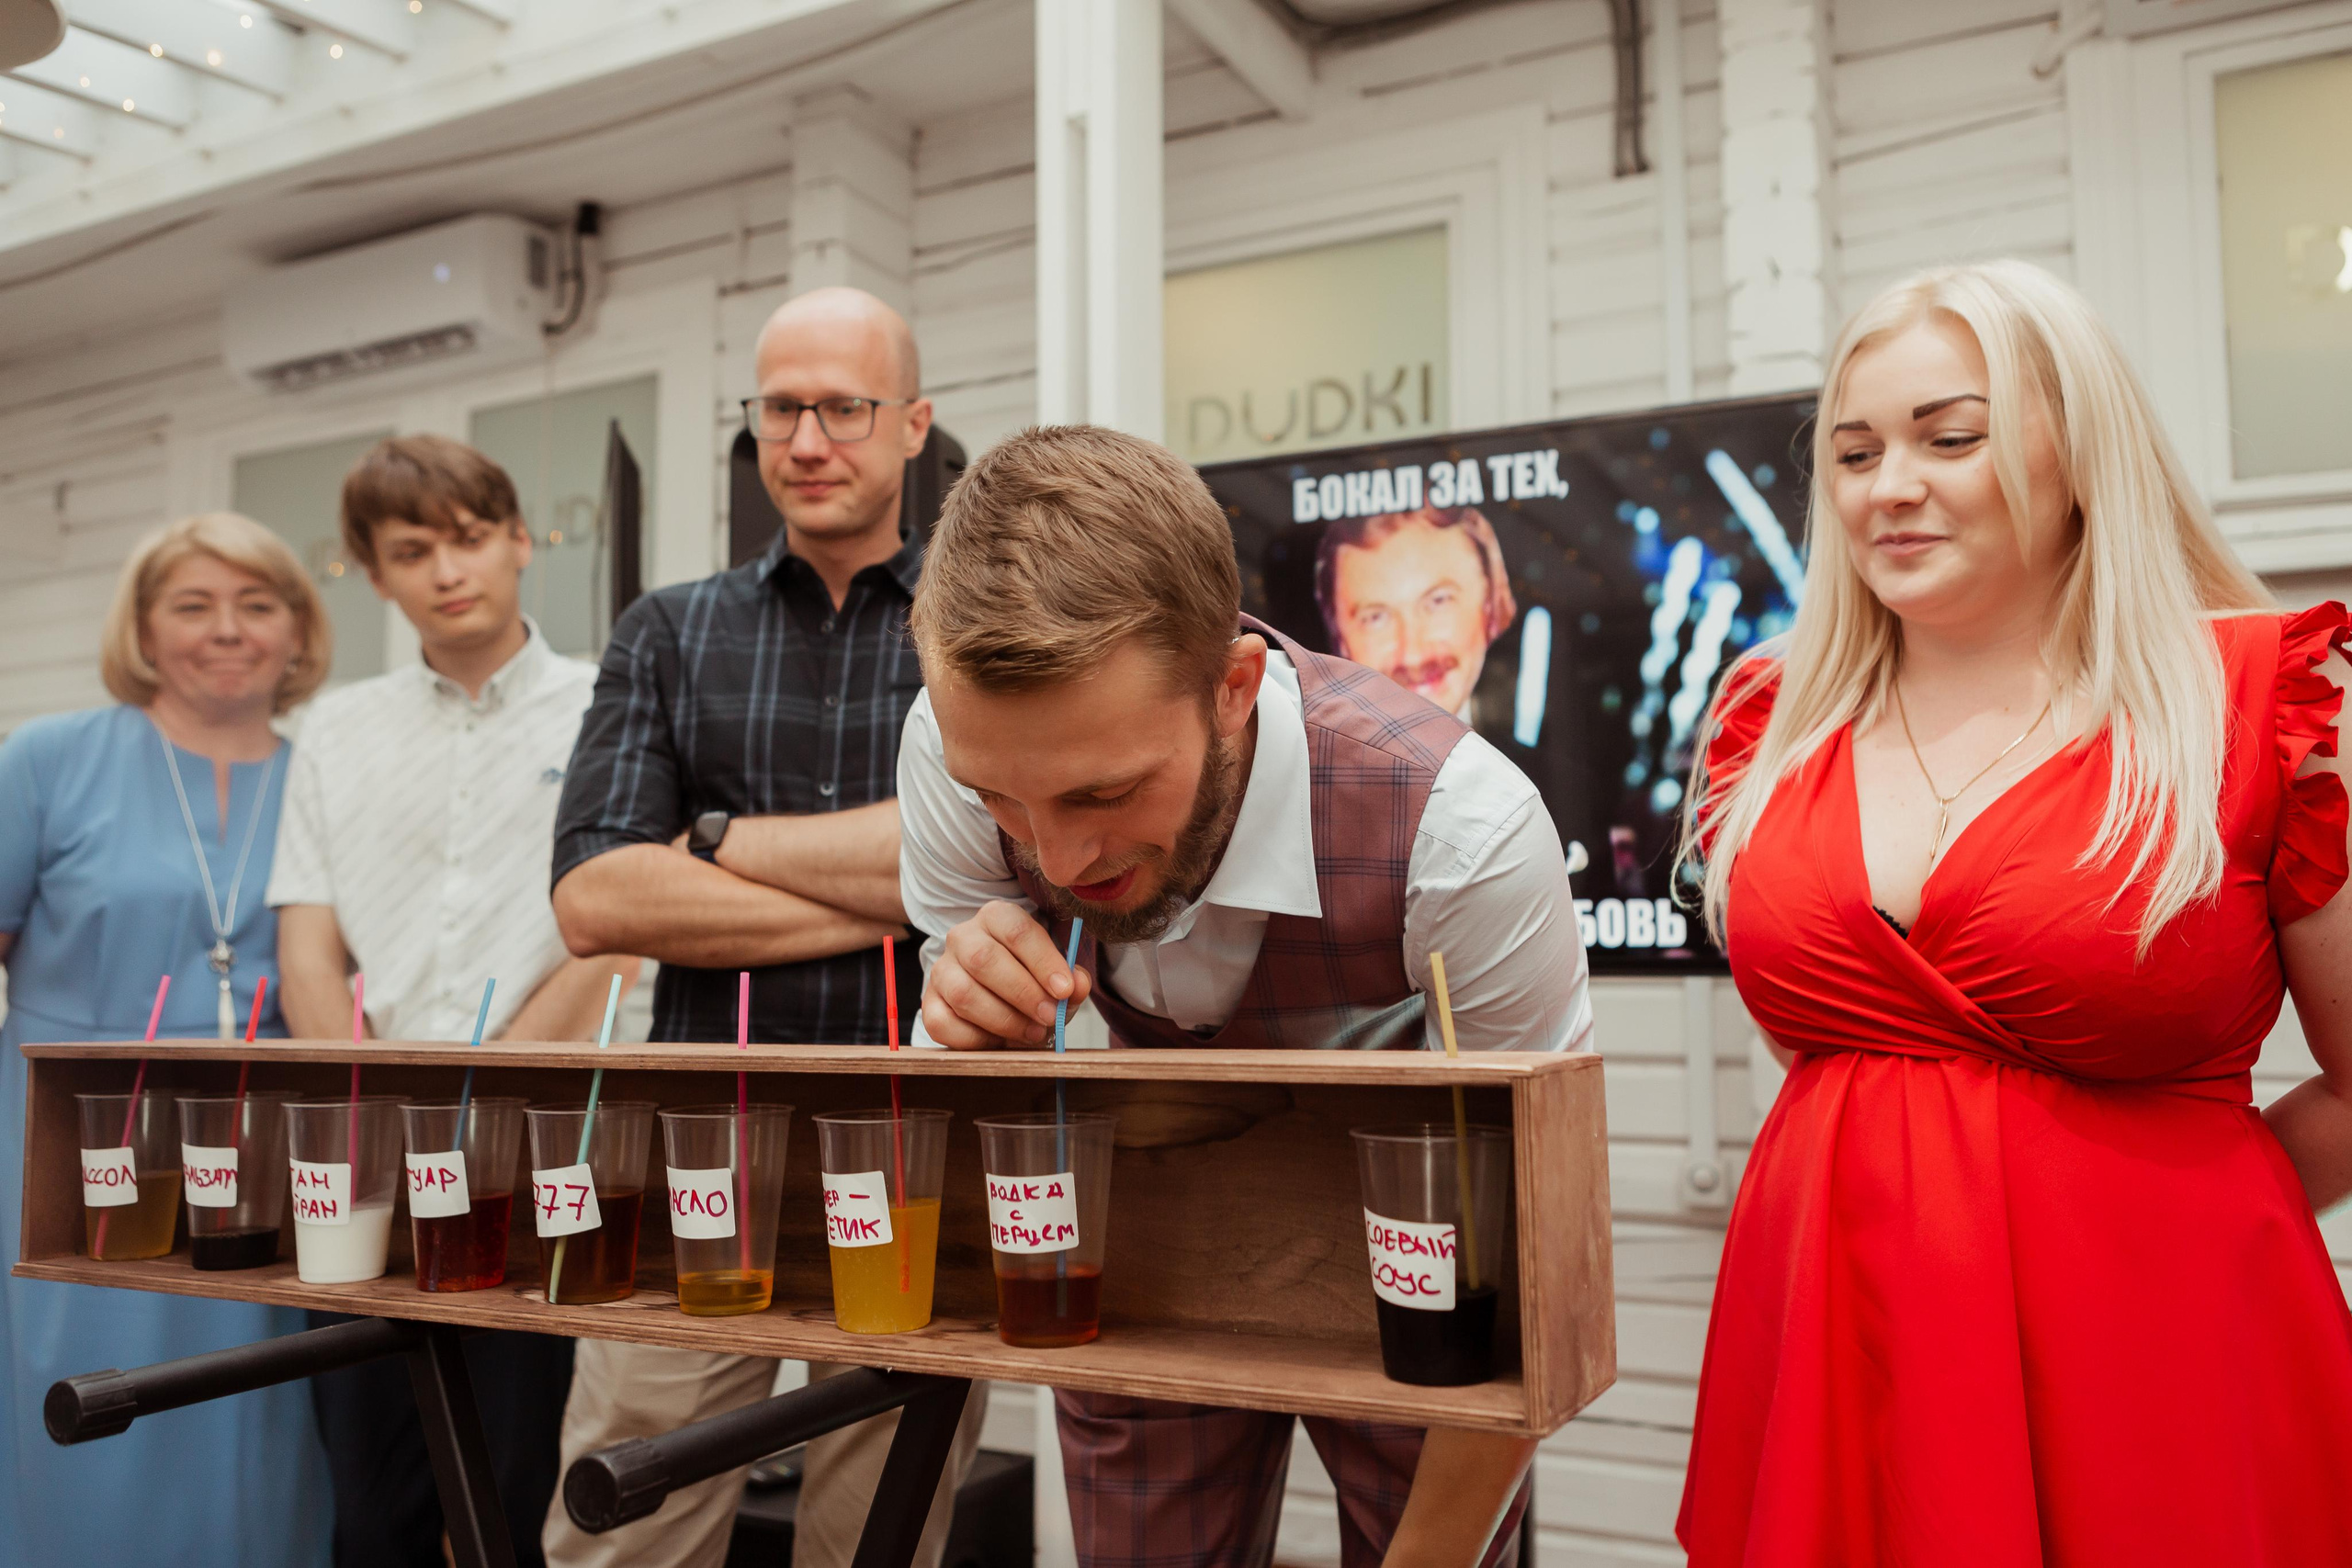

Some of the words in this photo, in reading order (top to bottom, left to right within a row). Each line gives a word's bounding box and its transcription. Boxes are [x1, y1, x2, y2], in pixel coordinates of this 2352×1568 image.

[1292, 464, 1424, 524] БОКАЛ
[1428, 458, 1485, 509] ЗА
[1486, 449, 1569, 502] ТЕХ,
[826, 1213, 881, 1241] ЕТИК
